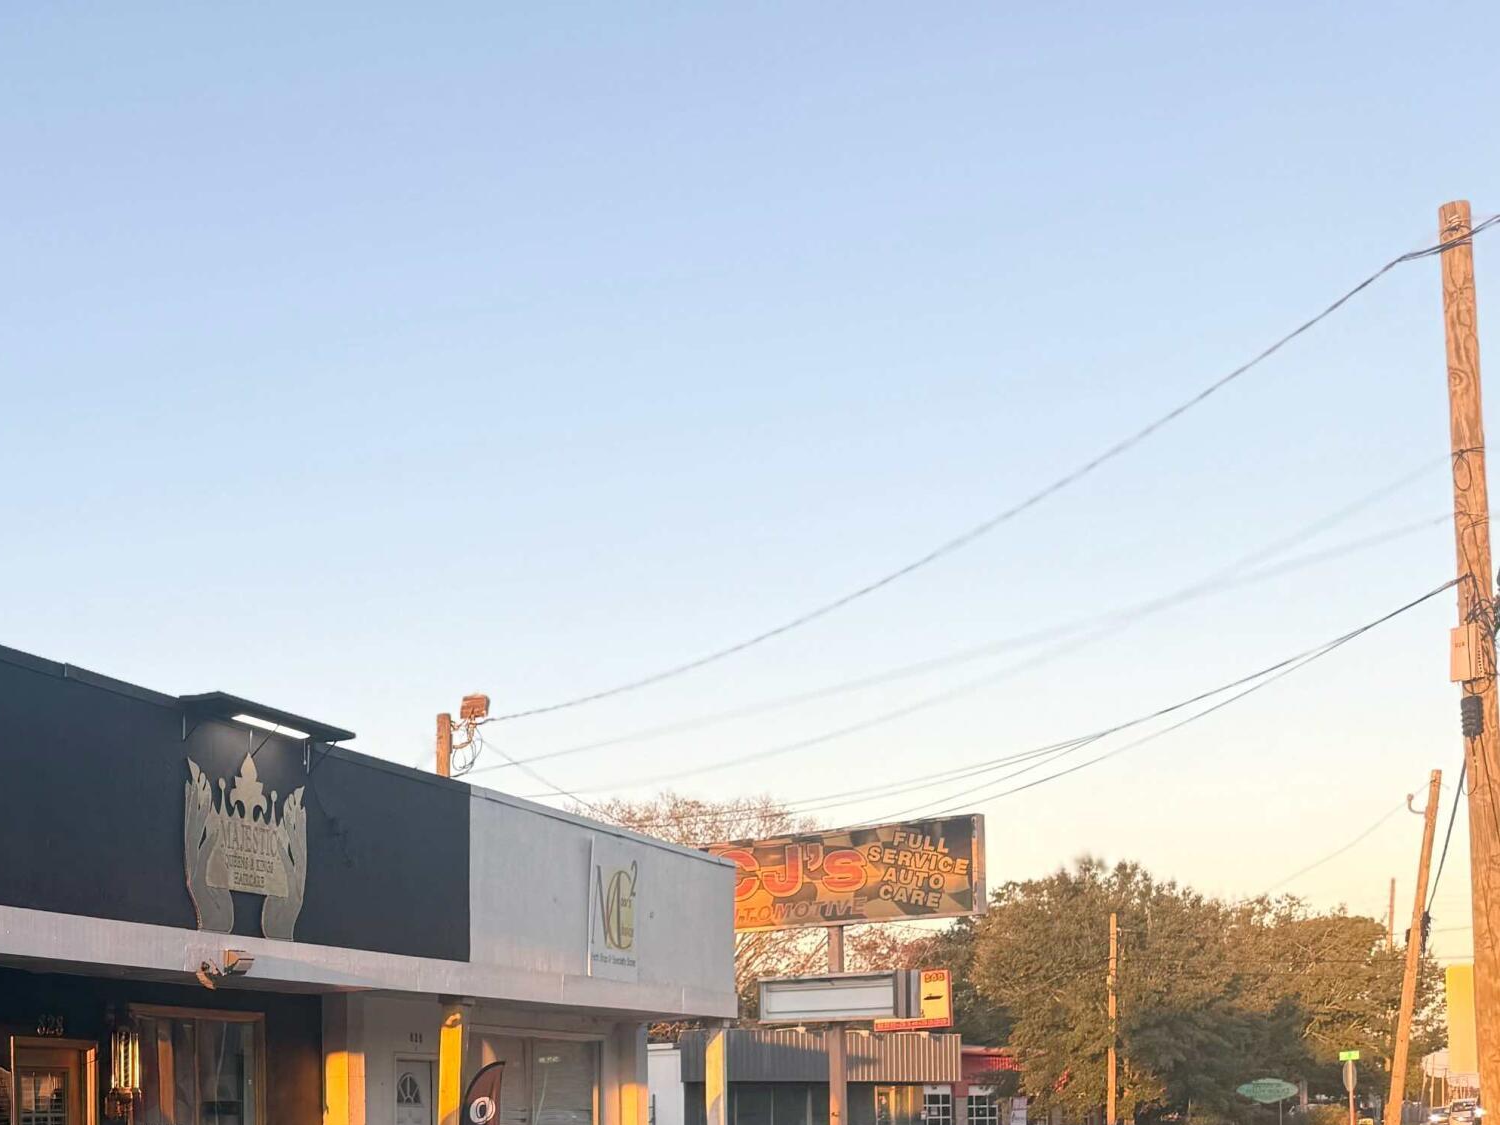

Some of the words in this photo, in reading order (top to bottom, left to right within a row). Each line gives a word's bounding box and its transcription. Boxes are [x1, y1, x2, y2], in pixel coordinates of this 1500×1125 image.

[220, 820, 278, 858] MAJESTIC
[893, 831, 949, 853] FULL
[868, 847, 969, 874] SERVICE
[883, 867, 945, 889] AUTO
[735, 896, 868, 921] TOMOTIVE
[879, 885, 941, 908] CARE
